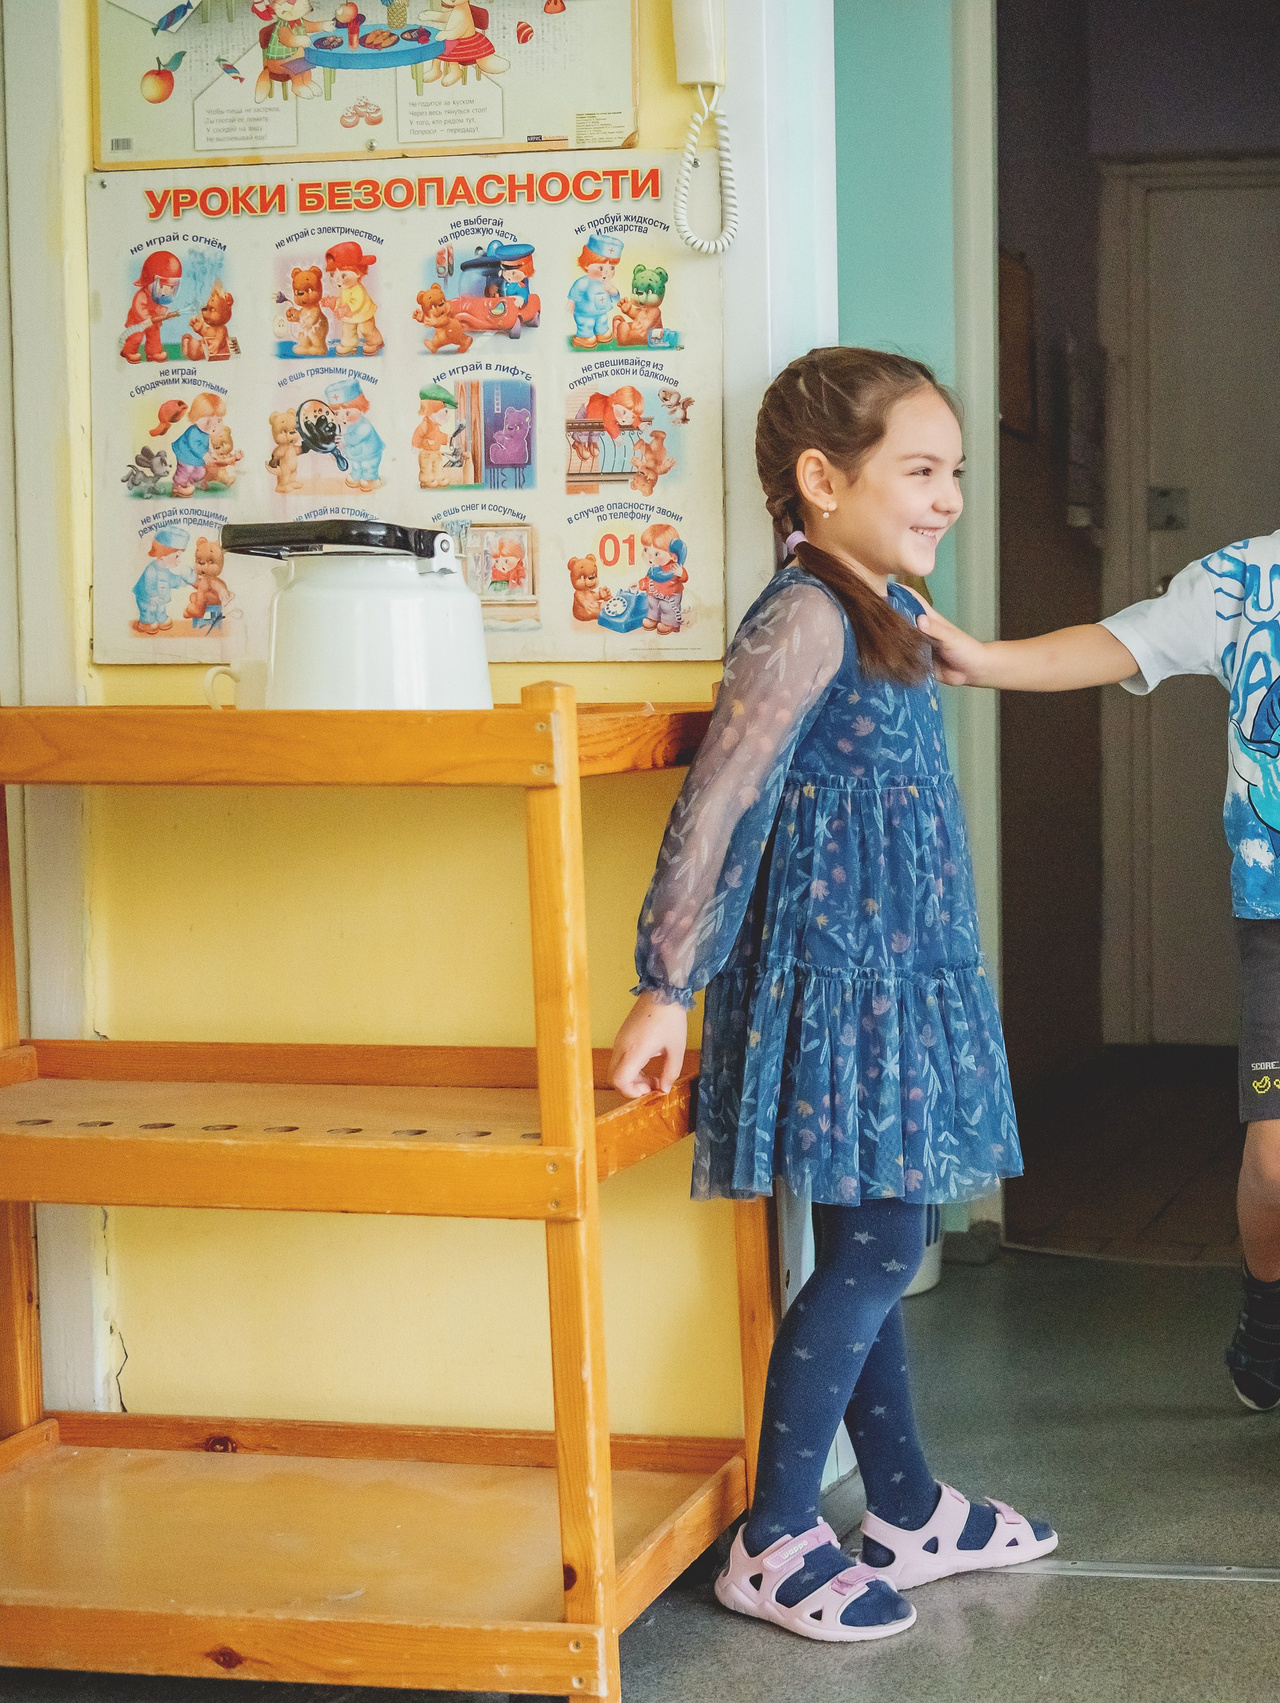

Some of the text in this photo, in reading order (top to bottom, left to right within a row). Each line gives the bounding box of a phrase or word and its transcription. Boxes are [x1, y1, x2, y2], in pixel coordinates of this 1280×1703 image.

[145, 167, 661, 220] УРОКИ БЕЗОПАСНОСТИ
[450, 214, 503, 230] не выбегай
[588, 213, 622, 232] пробуй
[623, 214, 670, 233] жидкости
[596, 224, 649, 236] и лекарства
[130, 231, 228, 255] не играй с огнём
[275, 238, 287, 250] не
[288, 228, 310, 245] играй
[317, 226, 384, 246] электричеством
[438, 227, 518, 246] на проезжую часть
[159, 366, 197, 378] не играй
[432, 372, 448, 384] не
[448, 361, 483, 377] играй
[494, 364, 532, 382] лифте
[582, 356, 664, 374] не свешивайся из
[129, 376, 228, 398] с бродячими животными
[278, 367, 379, 388] не ешь грязными руками
[568, 366, 680, 390] открытых окон и балконов
[140, 516, 152, 526] не
[152, 507, 178, 521] играй
[304, 506, 329, 521] играй
[330, 506, 340, 514] на
[430, 513, 442, 523] не
[442, 506, 460, 518] ешь
[461, 503, 480, 512] снег
[488, 503, 527, 522] сосульки
[566, 502, 683, 525] в случае опасности звони
[597, 510, 652, 523] по телефону
[138, 516, 222, 539] режущими предмета
[598, 533, 636, 567] 01
[1251, 1060, 1280, 1071] SCORE:
